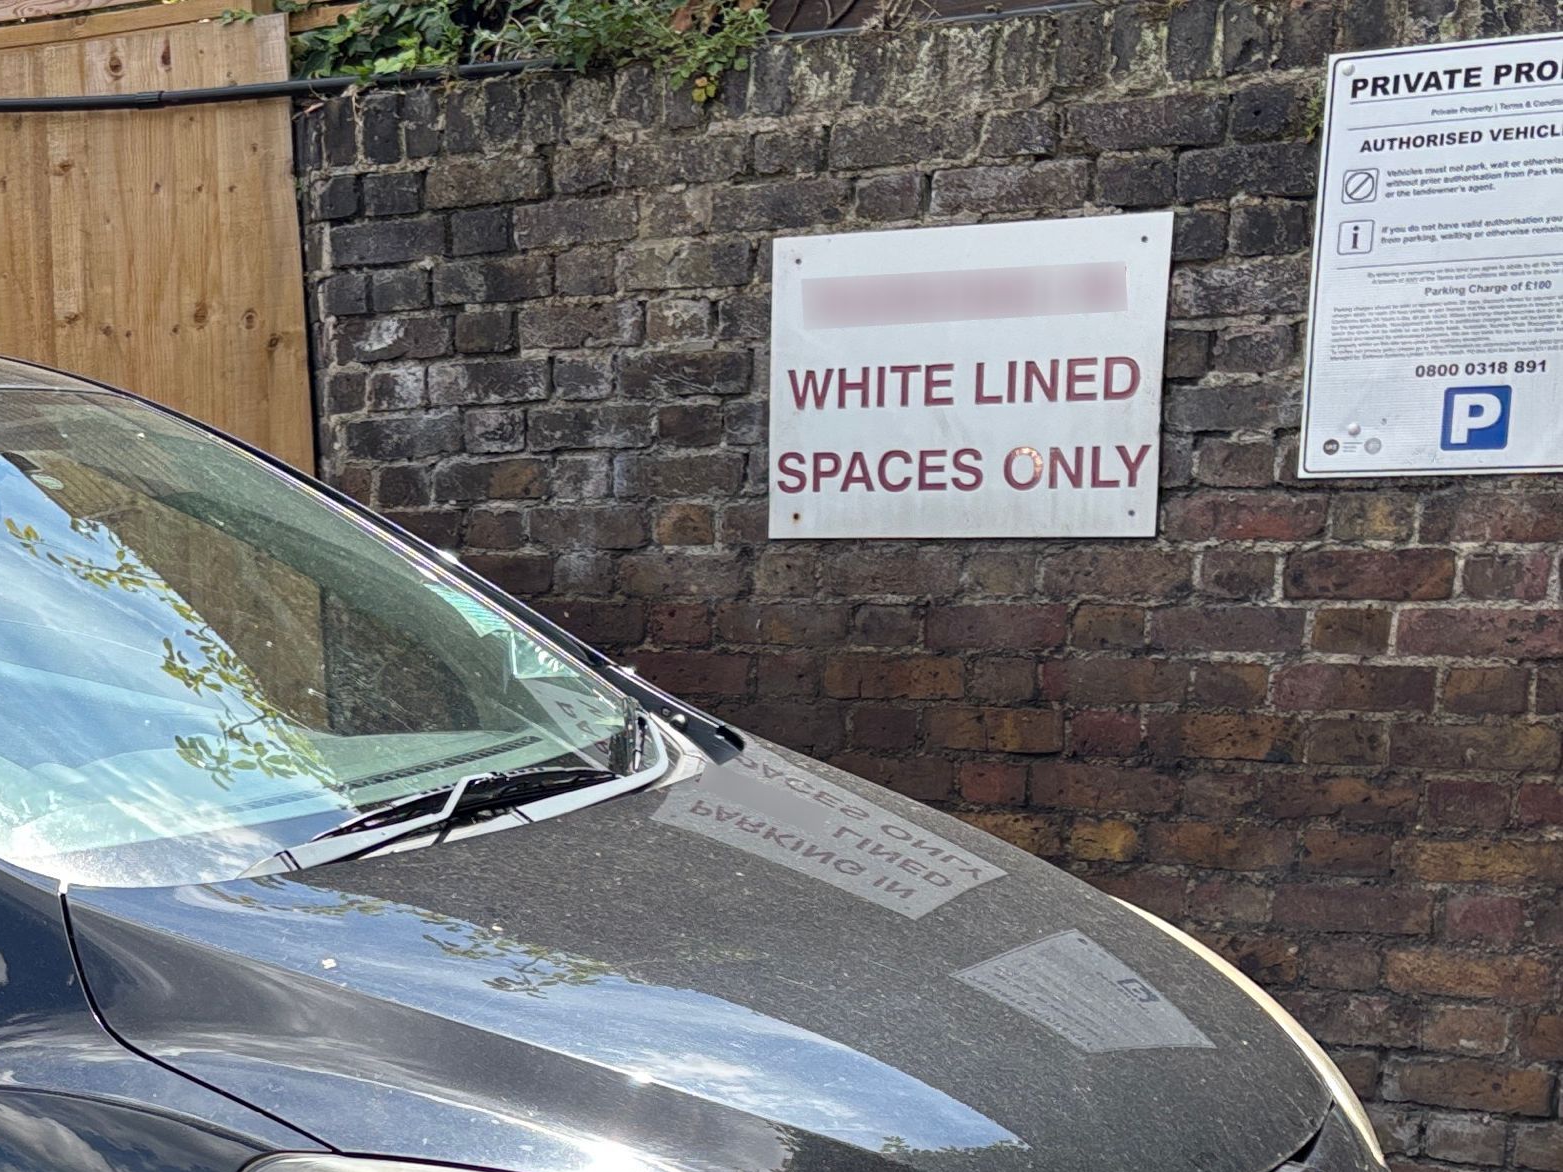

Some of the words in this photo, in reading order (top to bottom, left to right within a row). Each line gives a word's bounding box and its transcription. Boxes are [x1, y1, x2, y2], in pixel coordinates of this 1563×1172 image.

[1350, 66, 1483, 99] PRIVATE
[1493, 60, 1563, 85] PRO
[1360, 130, 1482, 153] AUTHORISED
[1489, 124, 1563, 142] VEHICL
[1386, 179, 1418, 188] without
[1444, 172, 1502, 184] authorisation
[1504, 170, 1525, 179] from
[1527, 168, 1548, 177] Park
[1387, 167, 1423, 177] Vehicles
[1425, 165, 1446, 174] must
[1449, 164, 1464, 172] not
[1490, 160, 1508, 169] wait
[1511, 160, 1521, 168] or
[1385, 191, 1394, 199] or
[1380, 236, 1401, 244] from
[1440, 231, 1472, 241] waiting
[1474, 230, 1484, 238] or
[1485, 226, 1529, 238] otherwise
[1390, 226, 1406, 235] you
[1408, 224, 1420, 232] do
[1421, 223, 1436, 231] not
[1437, 222, 1459, 230] have
[1484, 216, 1544, 227] authorisation
[1424, 285, 1466, 297] Parking
[1469, 284, 1508, 295] Charge
[1510, 281, 1524, 292] of
[1525, 280, 1553, 291] £100
[1415, 364, 1459, 378] 0800
[1465, 361, 1508, 376] 0318
[1515, 359, 1548, 374] 891
[788, 363, 955, 410] WHITE
[975, 356, 1142, 405] LINED
[1450, 393, 1502, 444] P
[776, 448, 984, 494] SPACES
[1003, 444, 1152, 491] ONLY
